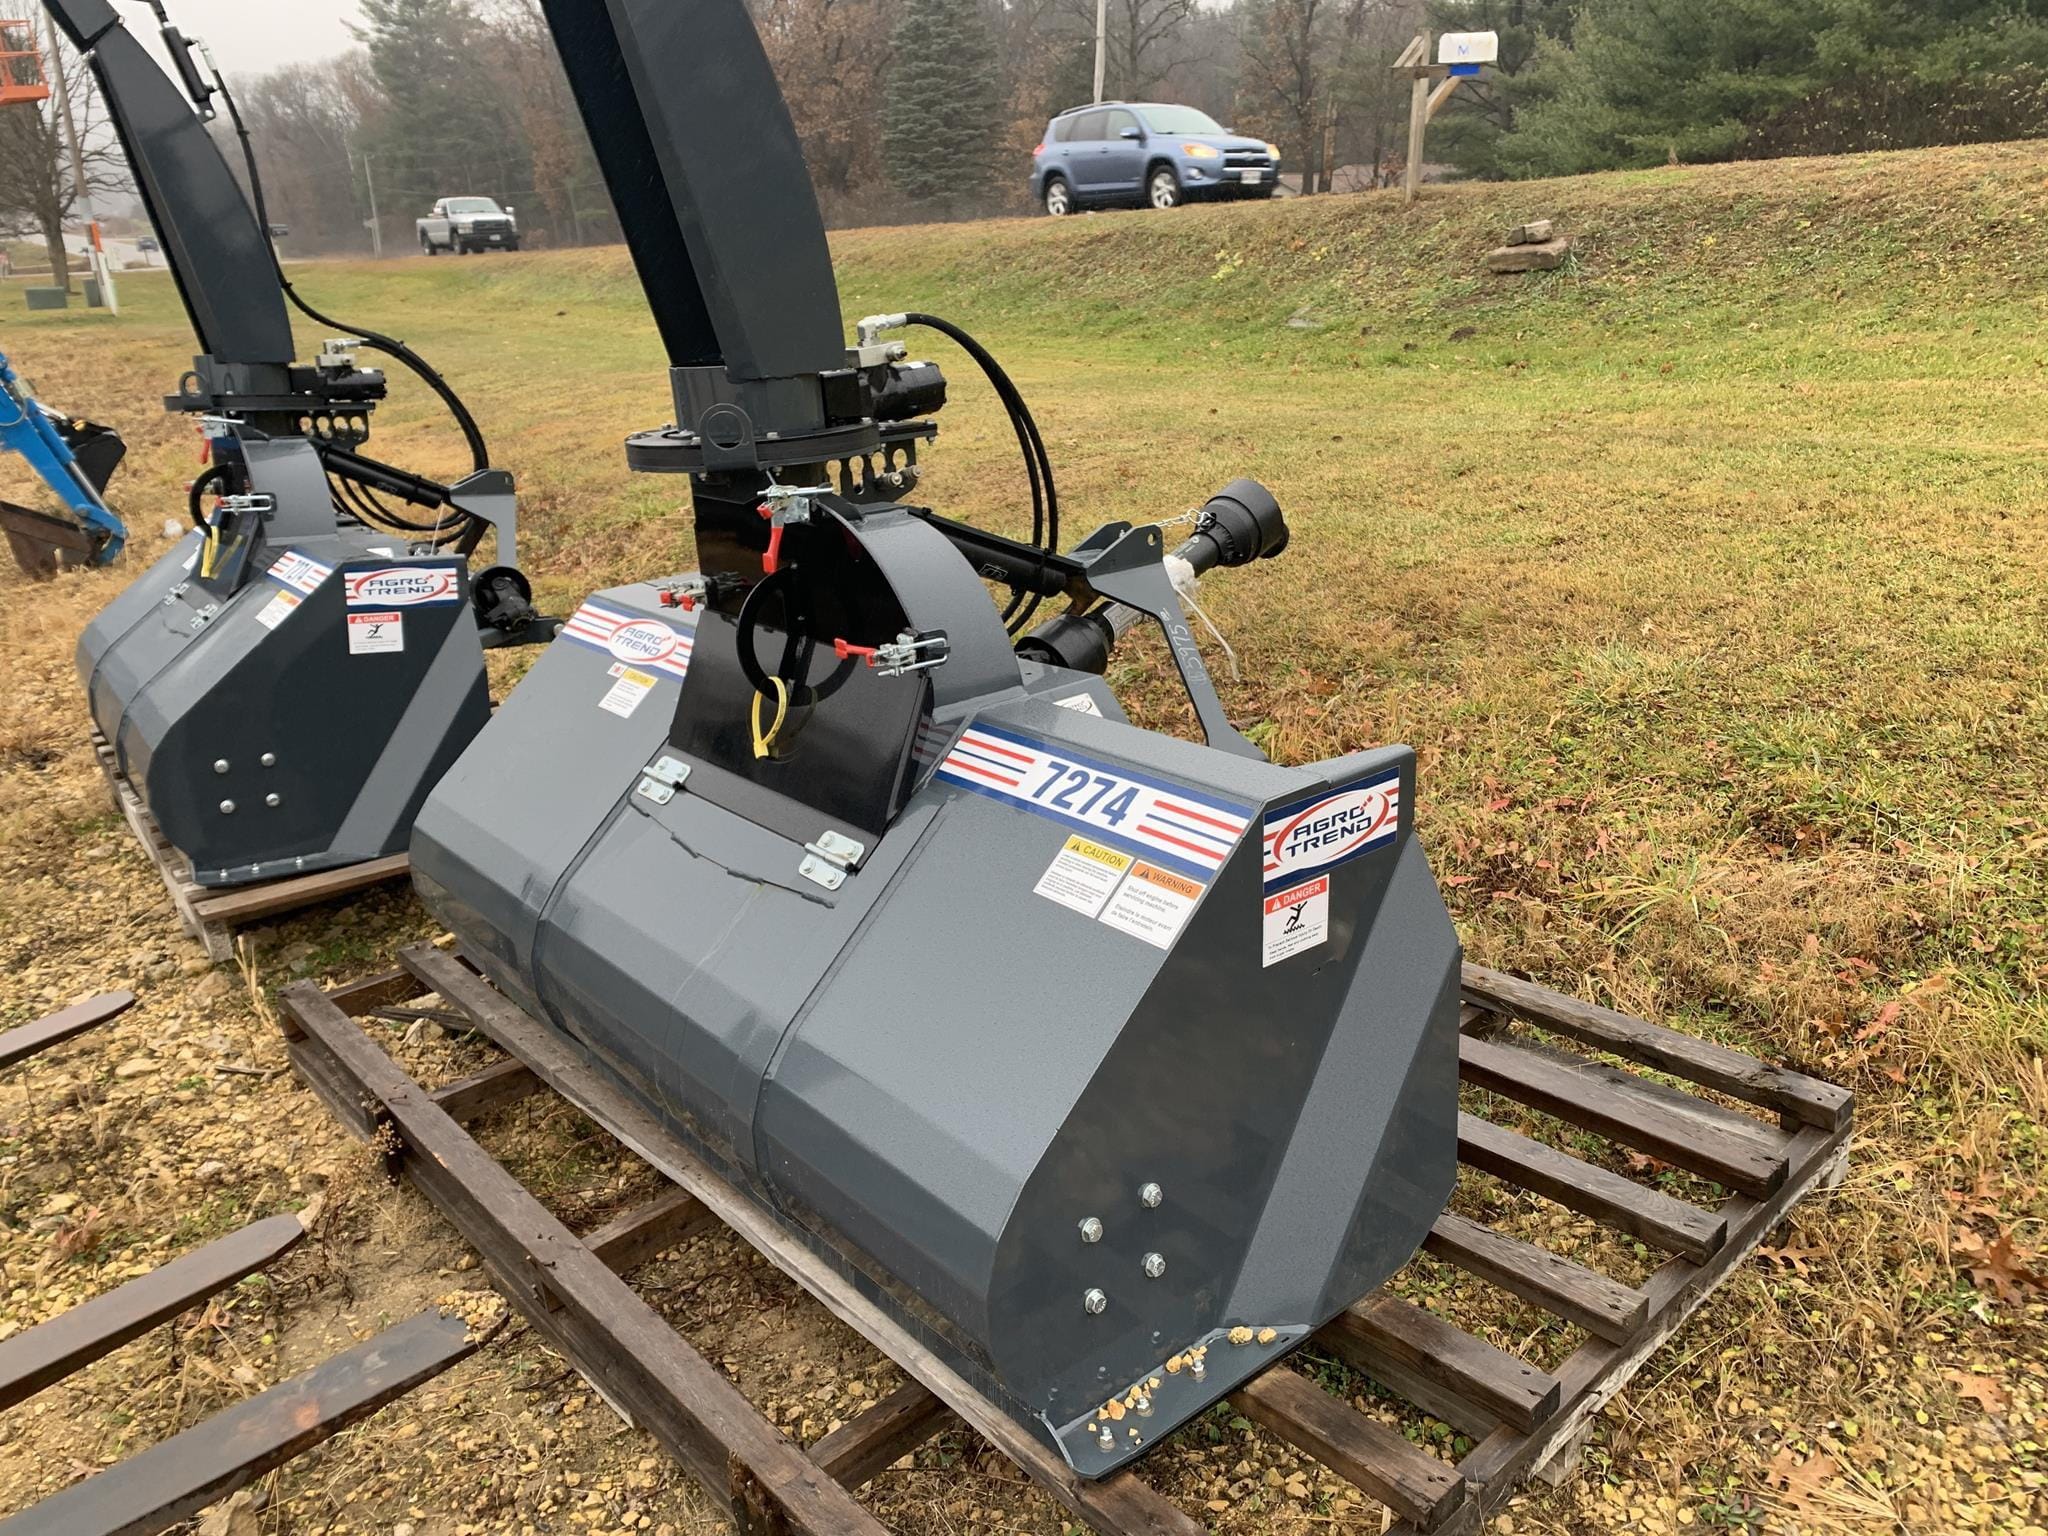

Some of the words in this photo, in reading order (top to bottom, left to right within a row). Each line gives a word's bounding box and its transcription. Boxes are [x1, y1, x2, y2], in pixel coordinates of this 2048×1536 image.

[364, 586, 434, 596] TREND
[369, 577, 428, 587] AGRO
[363, 615, 395, 623] DANGER
[615, 635, 661, 656] TREND
[624, 627, 662, 645] AGRO
[1032, 761, 1140, 826] 7274
[1293, 805, 1365, 841] AGRO
[1285, 816, 1372, 858] TREND
[1083, 845, 1124, 867] CAUTION
[1152, 872, 1193, 894] WARNING
[1283, 882, 1321, 906] DANGER
